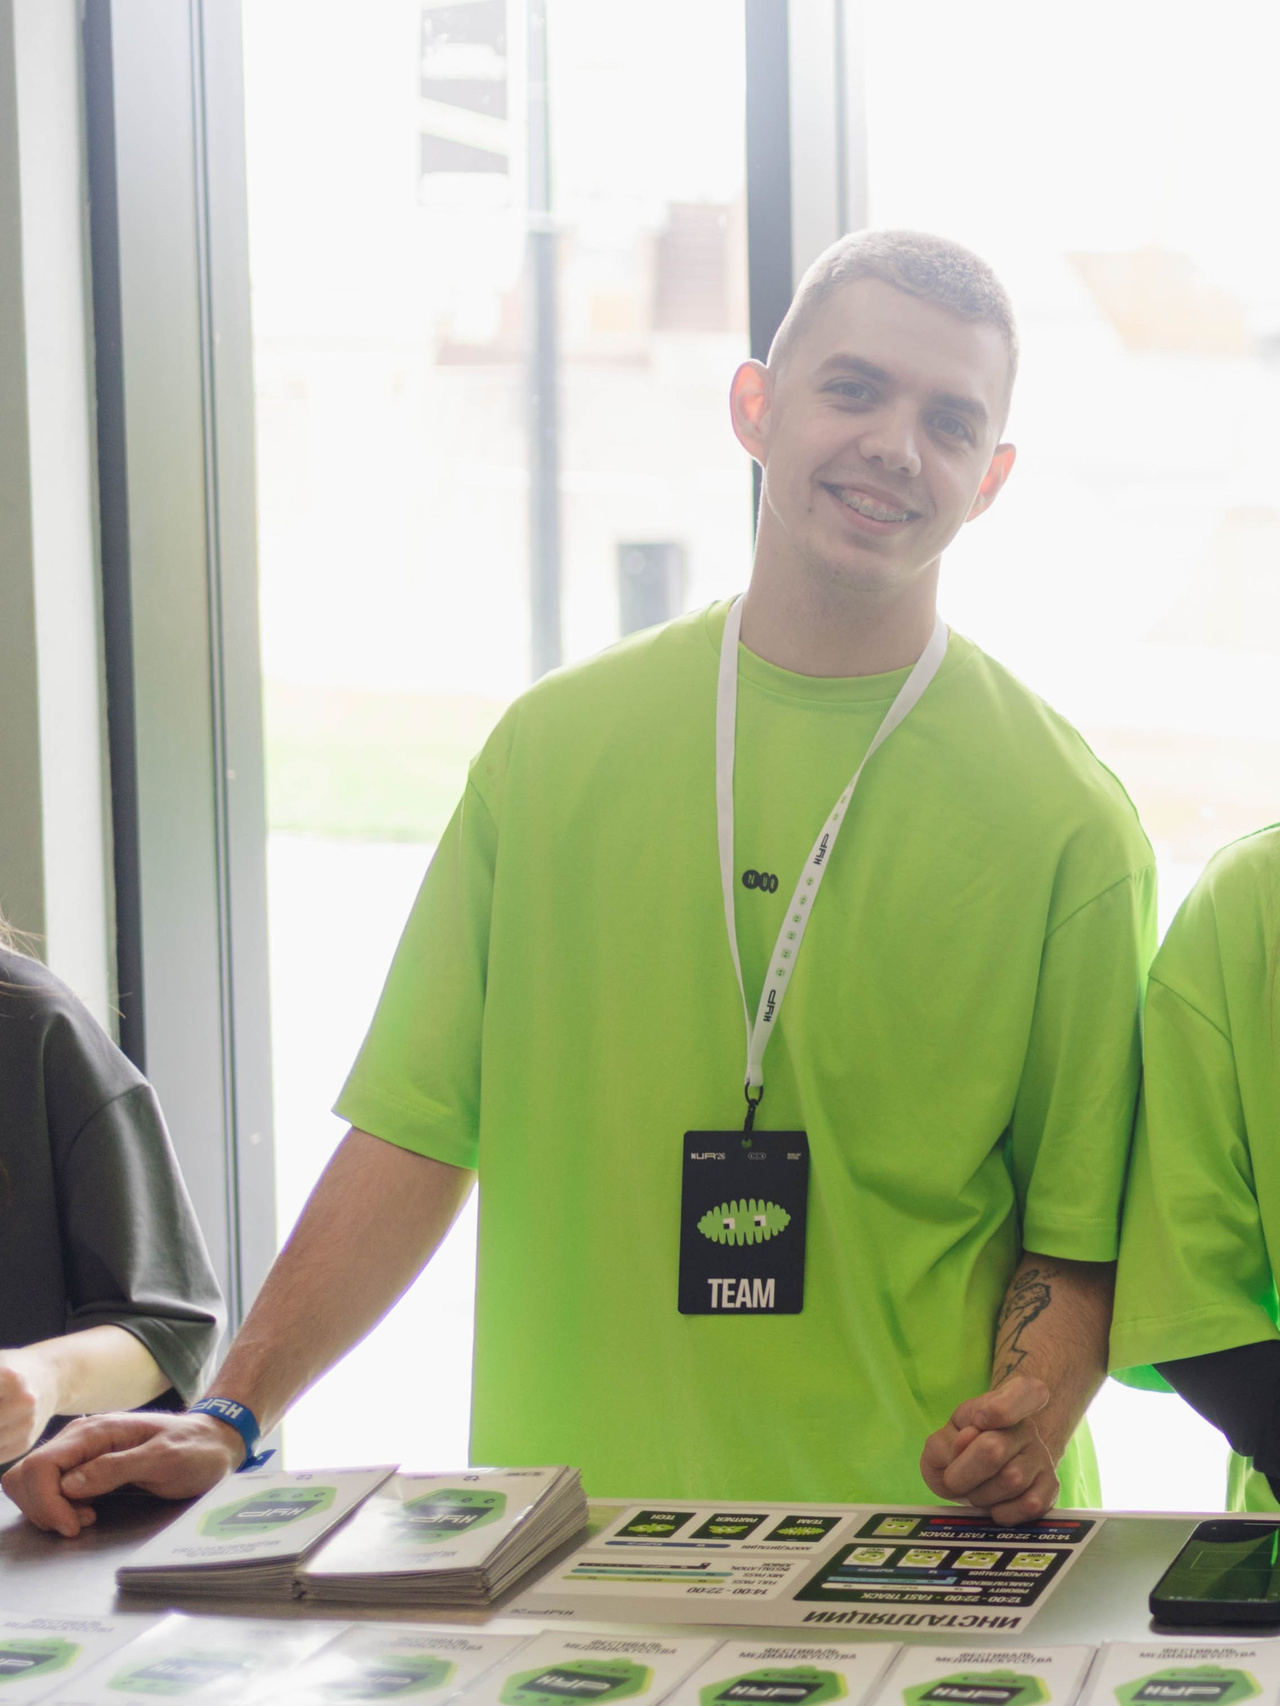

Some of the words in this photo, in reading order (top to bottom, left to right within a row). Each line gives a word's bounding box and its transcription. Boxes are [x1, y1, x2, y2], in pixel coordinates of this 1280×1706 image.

[746, 872, 777, 891] NUR
[707, 1278, 776, 1309] TEAM
[650, 1513, 676, 1521] TECH
[997, 1532, 1032, 1540] 22:00
[860, 1592, 901, 1600] TRACK
[901, 1593, 933, 1601] FAST
[802, 1610, 1022, 1629] ИНСТАЛЛЯЦИИ
